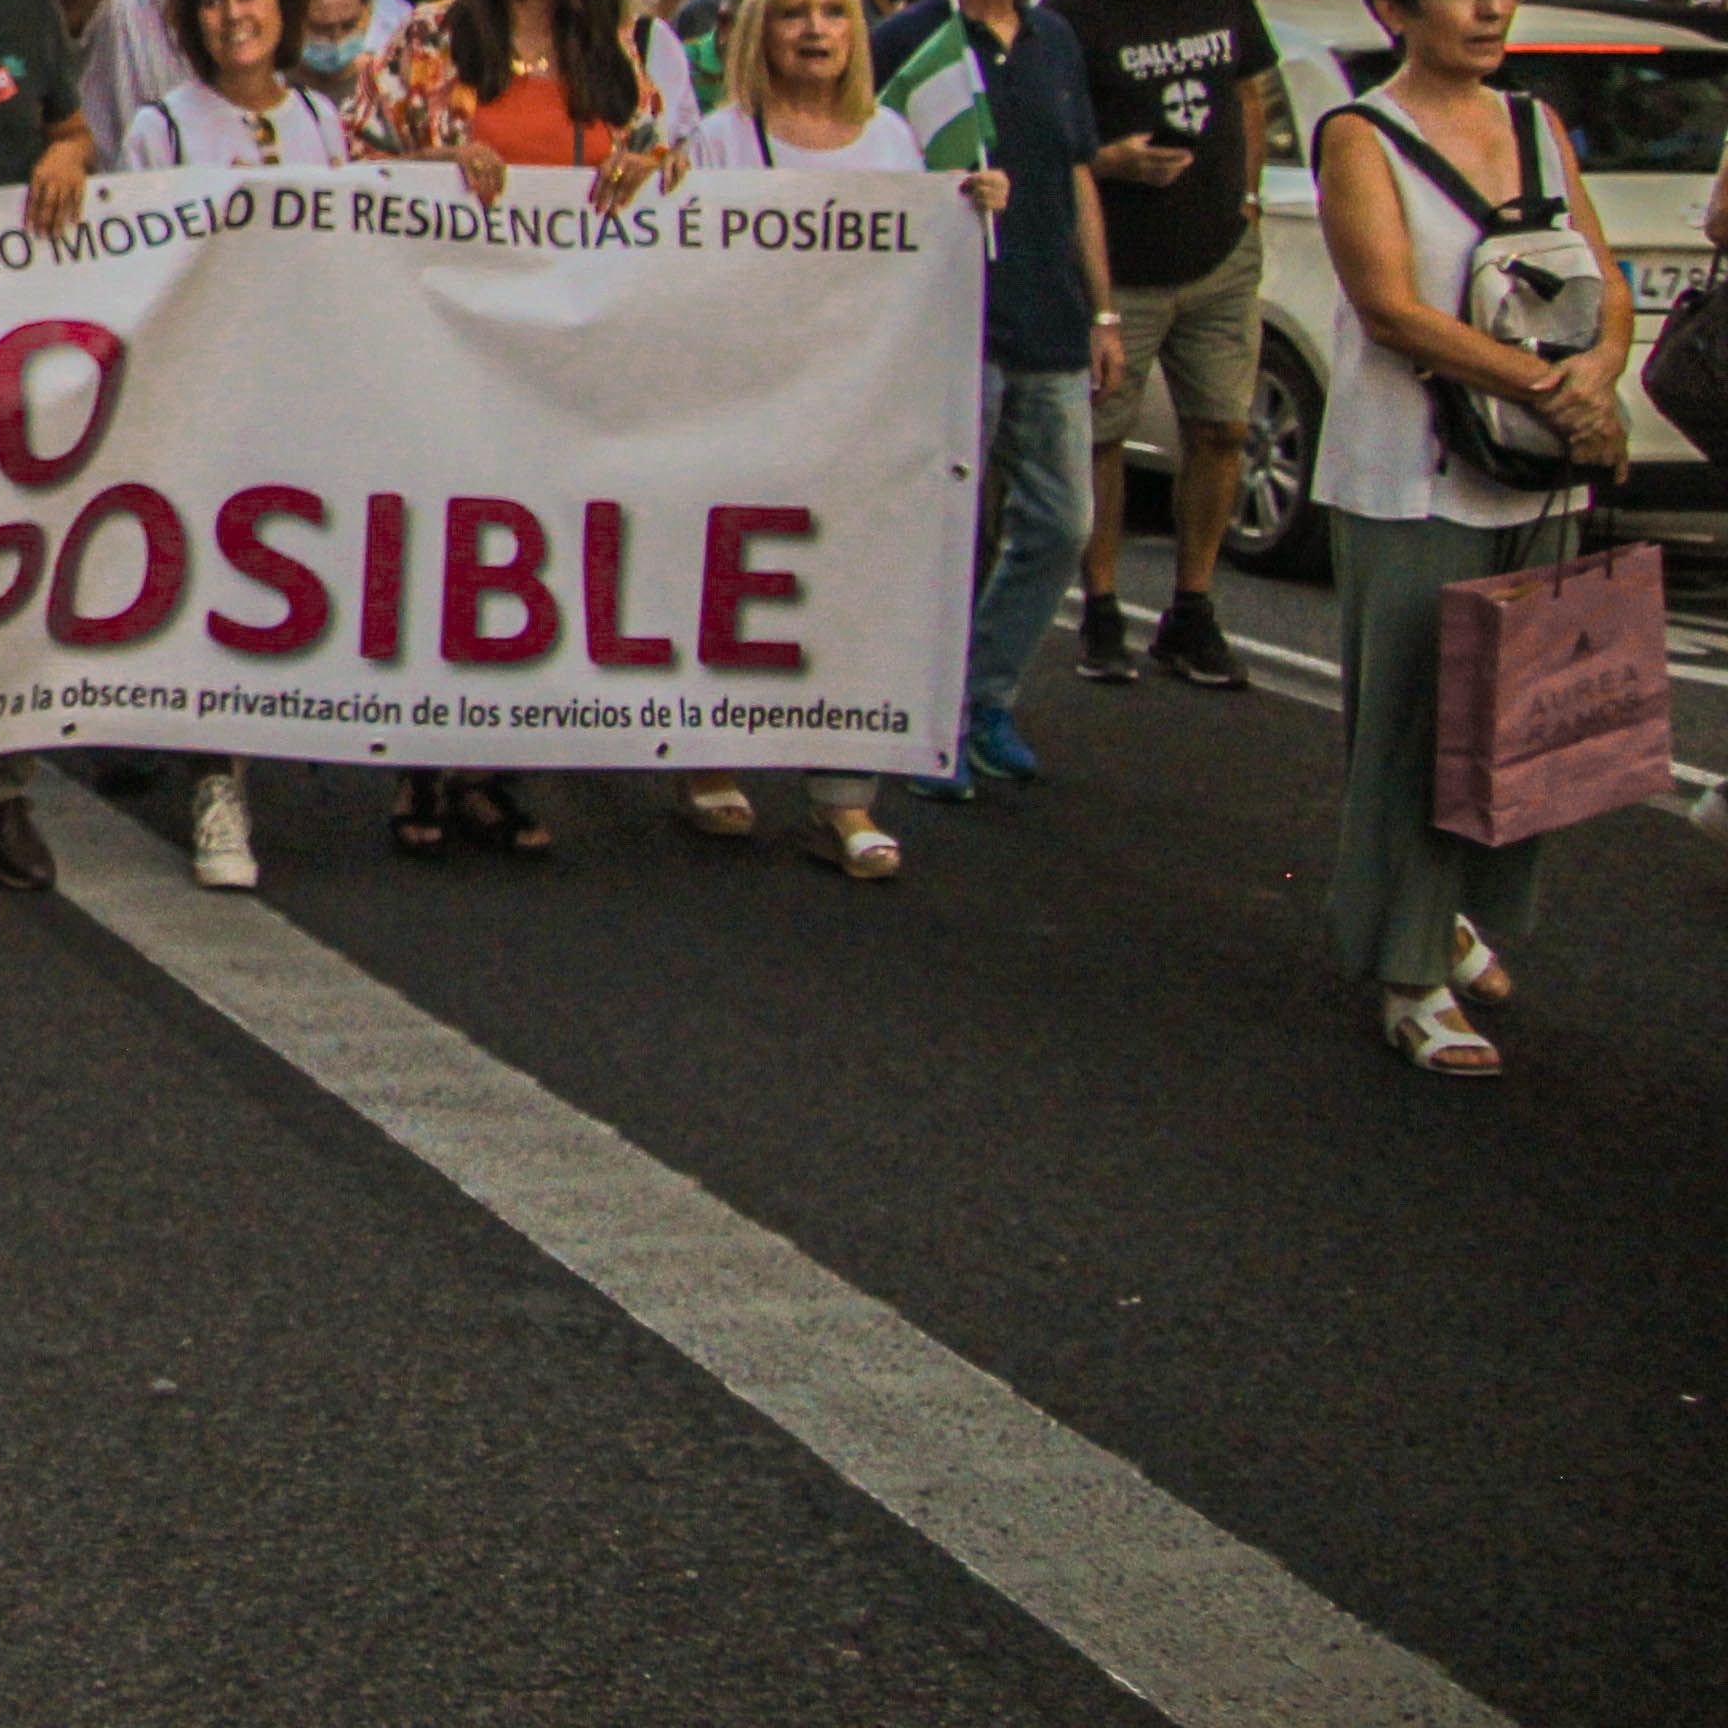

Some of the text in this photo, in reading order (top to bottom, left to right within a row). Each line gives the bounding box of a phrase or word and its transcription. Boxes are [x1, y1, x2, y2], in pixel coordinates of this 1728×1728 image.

[51, 189, 254, 268] MODELO
[272, 188, 337, 232] DE
[352, 190, 660, 250] RESIDENCIAS
[677, 196, 703, 250] É
[719, 198, 919, 254] POSÍBEL
[9, 694, 26, 718] a
[29, 682, 54, 713] la
[60, 676, 187, 713] obscena
[197, 686, 403, 730] privatización
[413, 694, 451, 727] de
[459, 695, 502, 729] los
[509, 696, 633, 730] servicios
[641, 695, 674, 729] de
[679, 696, 704, 729] la
[713, 698, 911, 736] dependencia
